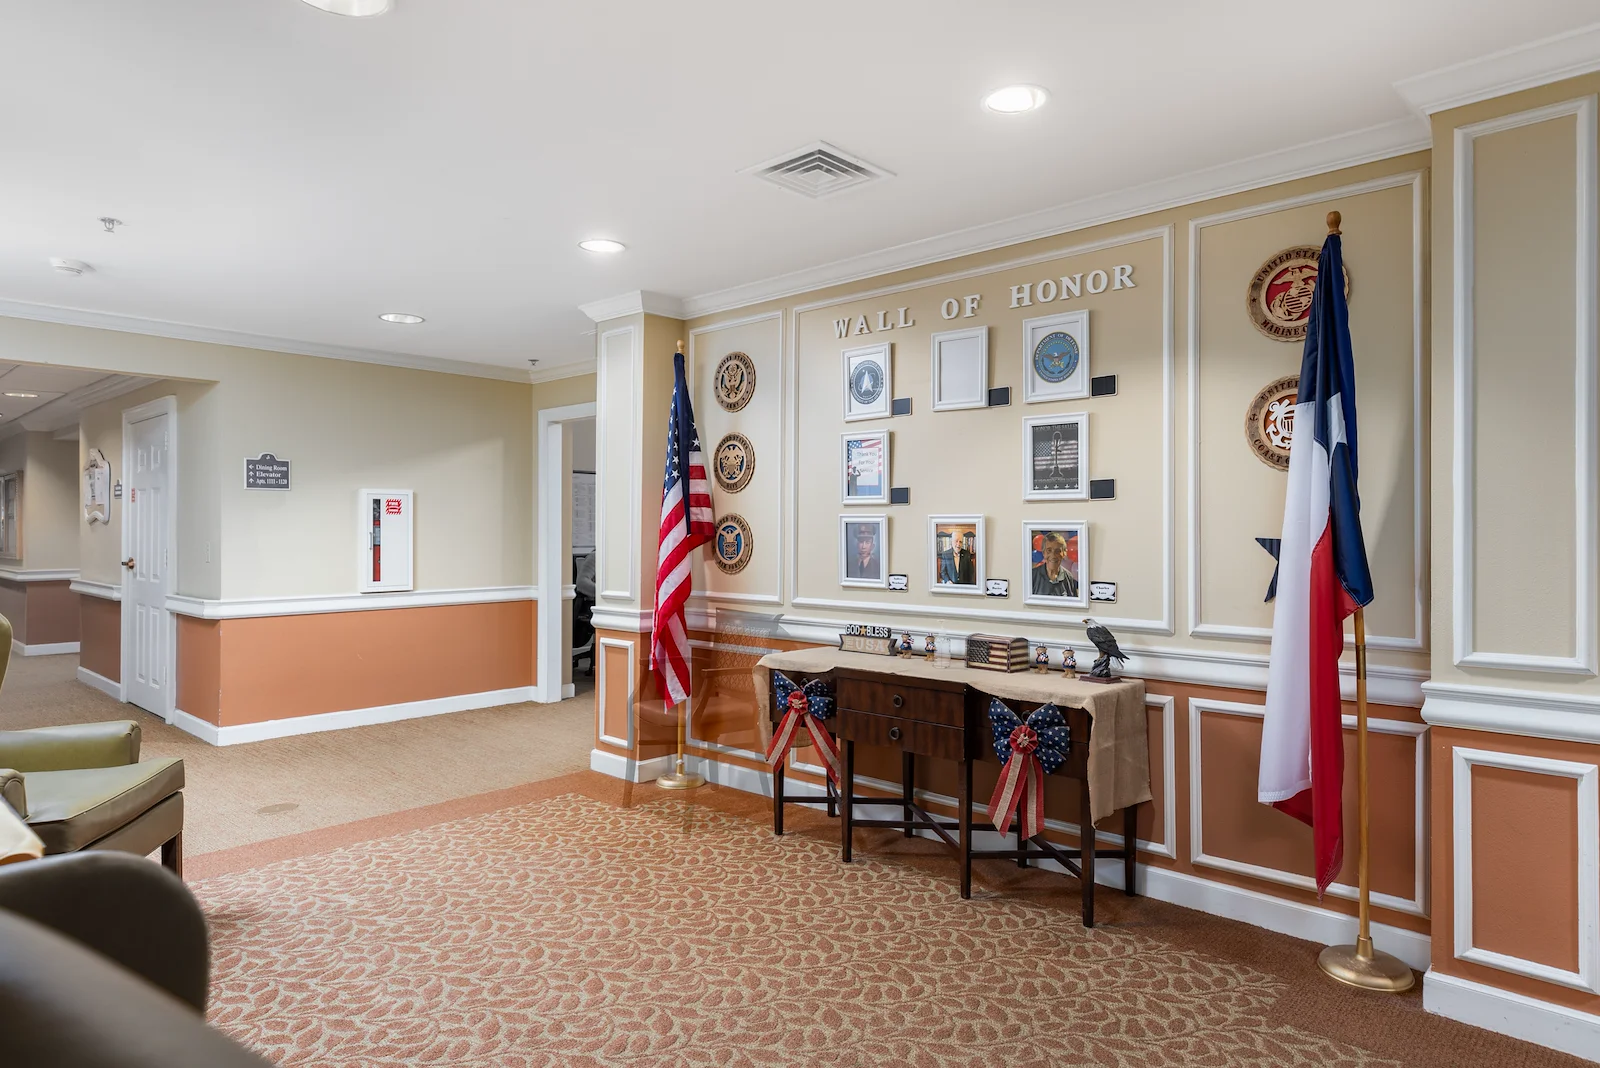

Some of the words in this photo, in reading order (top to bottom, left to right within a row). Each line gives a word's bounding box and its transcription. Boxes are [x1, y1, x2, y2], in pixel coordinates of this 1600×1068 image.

[1256, 252, 1293, 283] UNITED
[1295, 250, 1323, 262] STAT
[833, 306, 916, 339] WALL
[940, 294, 982, 320] OF
[1008, 264, 1136, 309] HONOR
[1261, 319, 1301, 337] MARINE
[1253, 438, 1283, 464] COAST
[255, 463, 273, 472] Dining
[273, 464, 288, 472] Room
[256, 470, 282, 478] Elevator
[845, 623, 861, 636] GOD
[866, 626, 889, 638] BLESS
[854, 638, 886, 653] USA
